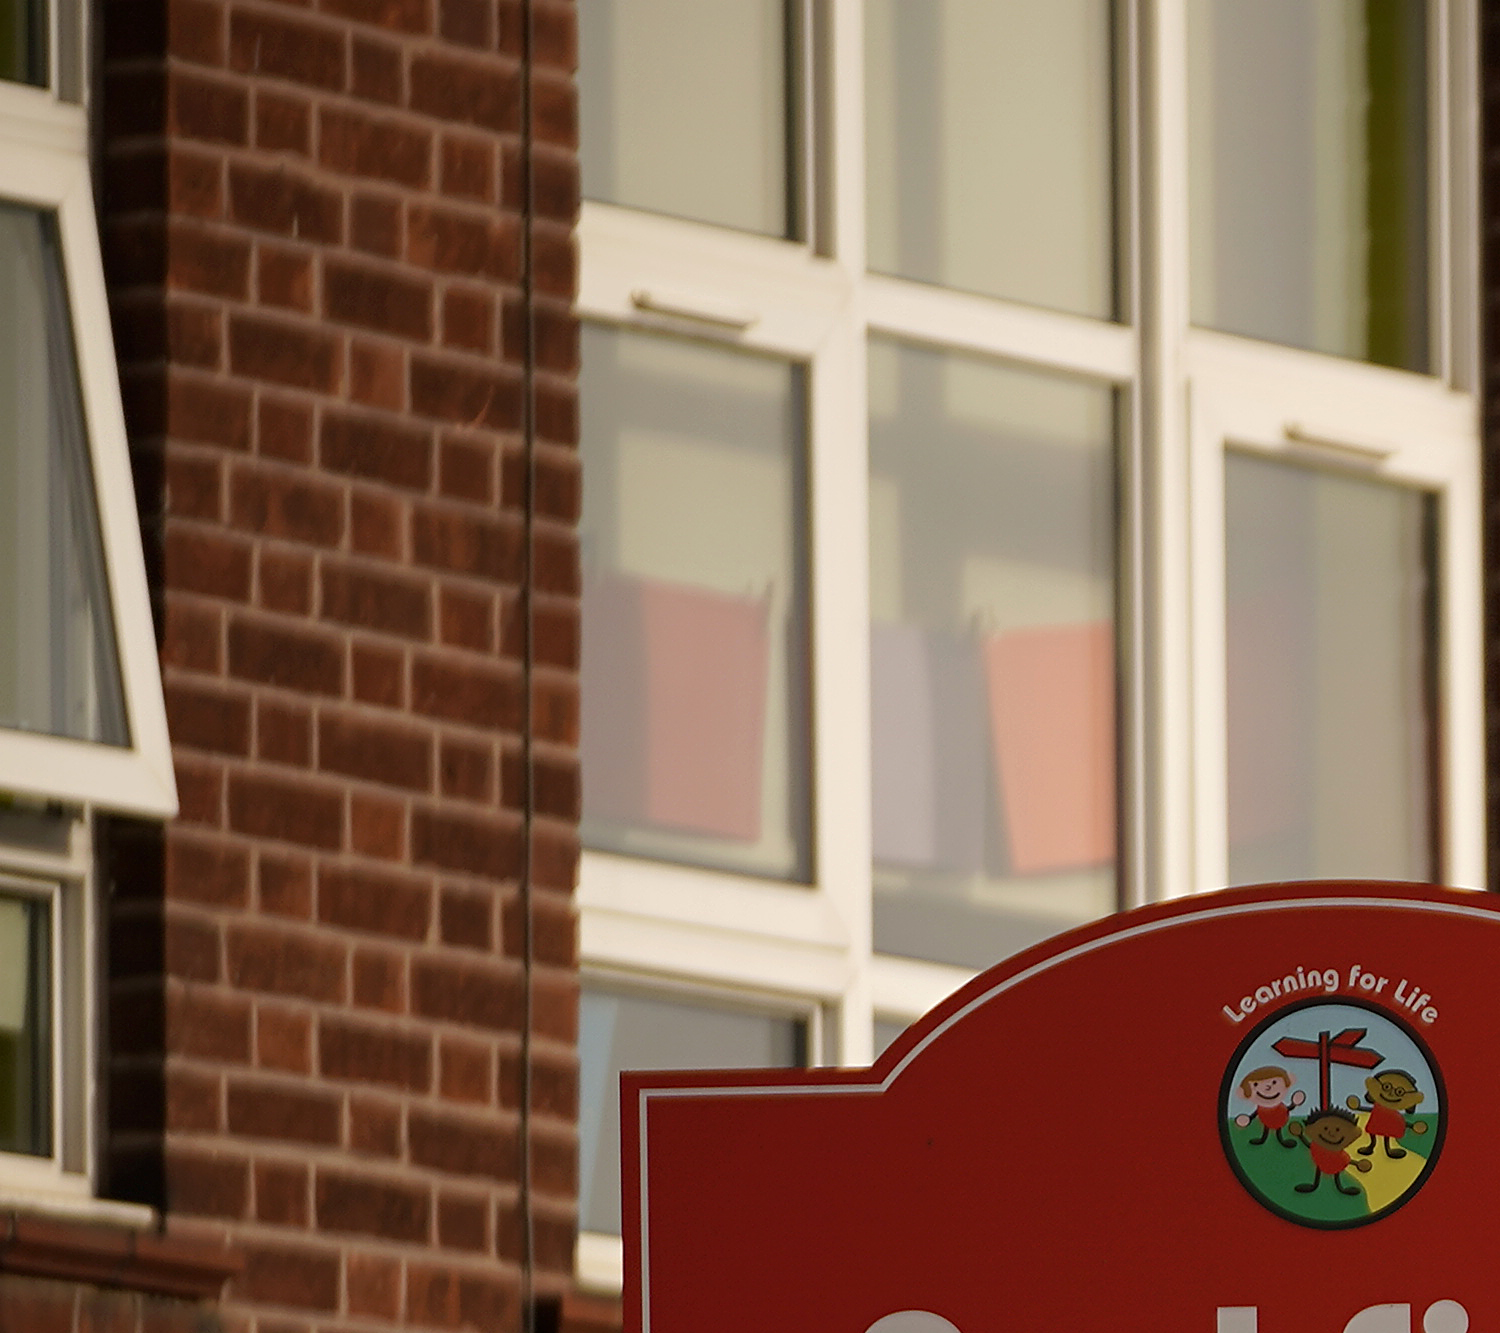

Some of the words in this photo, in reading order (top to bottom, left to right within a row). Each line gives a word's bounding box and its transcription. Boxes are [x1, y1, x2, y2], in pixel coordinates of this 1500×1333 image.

[1222, 966, 1340, 1024] Learning
[1349, 965, 1389, 993] for
[1394, 979, 1439, 1024] Life
